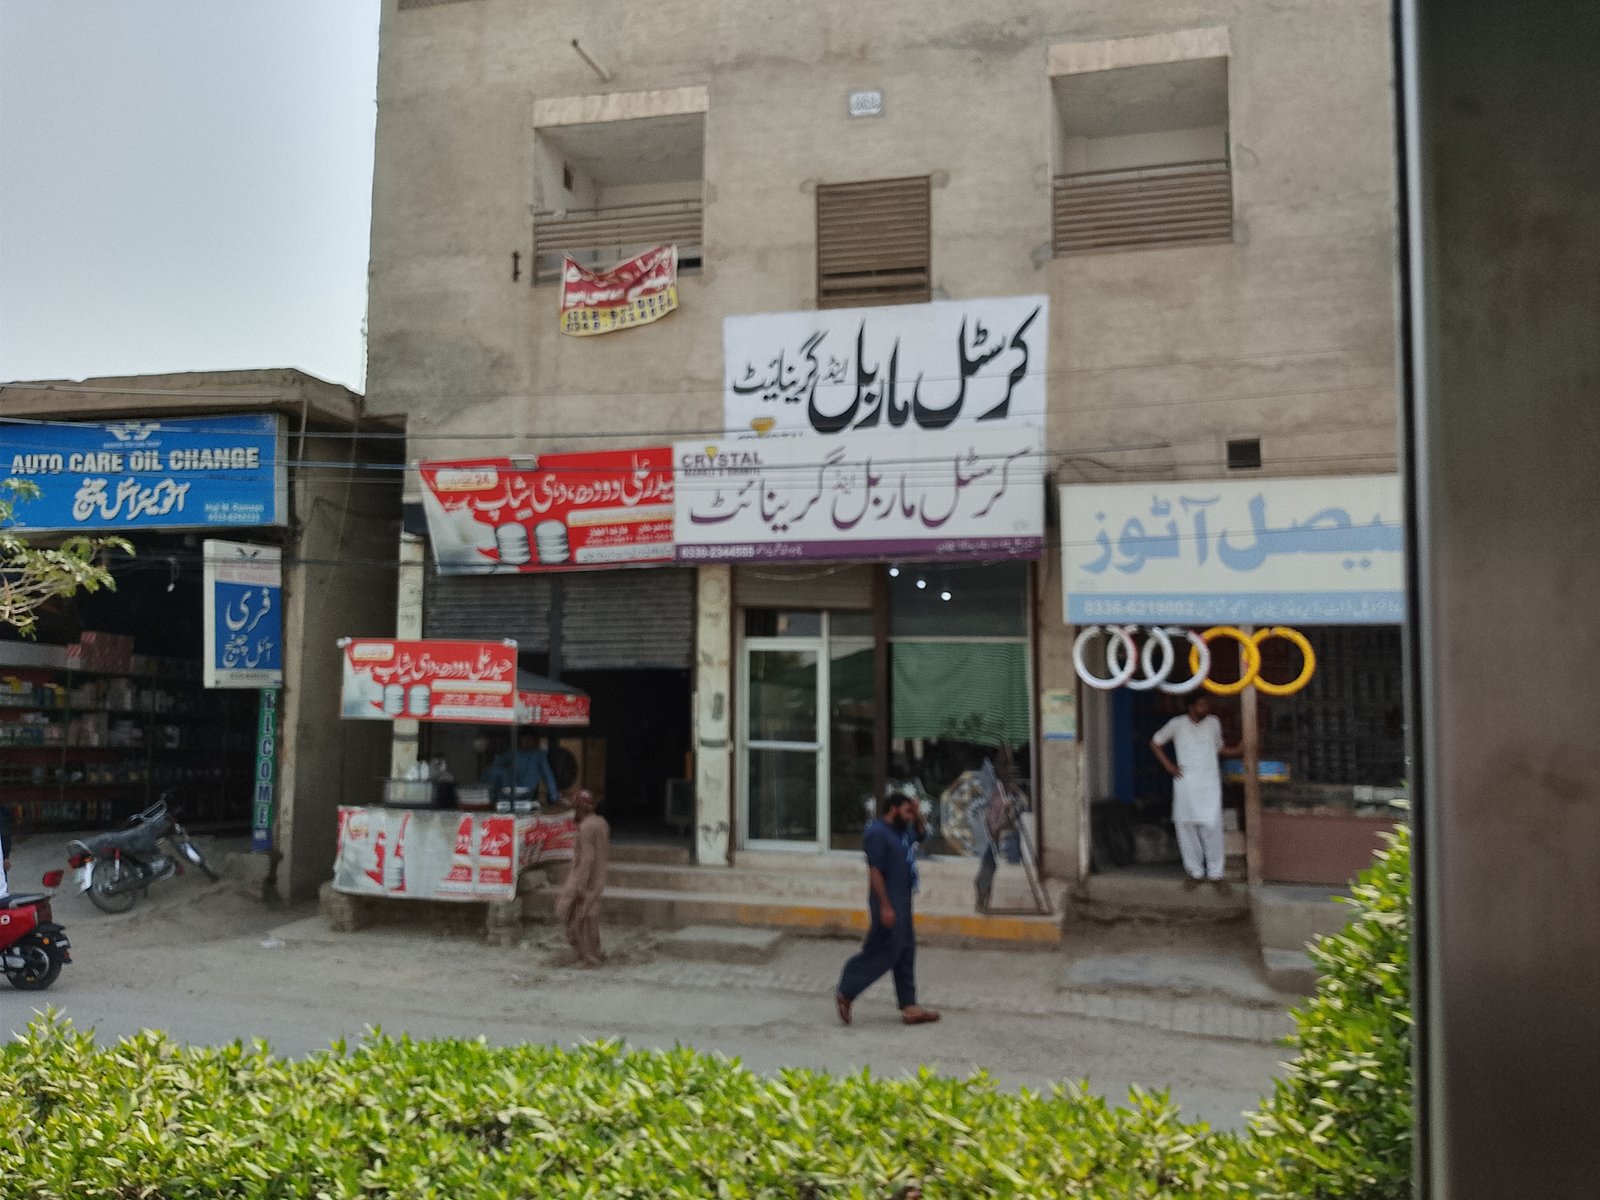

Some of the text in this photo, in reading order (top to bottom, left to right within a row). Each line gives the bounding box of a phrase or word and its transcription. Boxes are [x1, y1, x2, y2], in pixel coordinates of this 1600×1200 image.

[808, 317, 909, 435] ماربل
[912, 303, 1042, 431] کرسٹل
[11, 447, 260, 474] AUTO CARE OIL CHANGE
[682, 447, 763, 468] CRYSTAL
[832, 455, 915, 530] ماربل
[920, 445, 1032, 528] کرسٹل
[1080, 494, 1220, 575] آٹوز
[225, 587, 271, 632] فری
